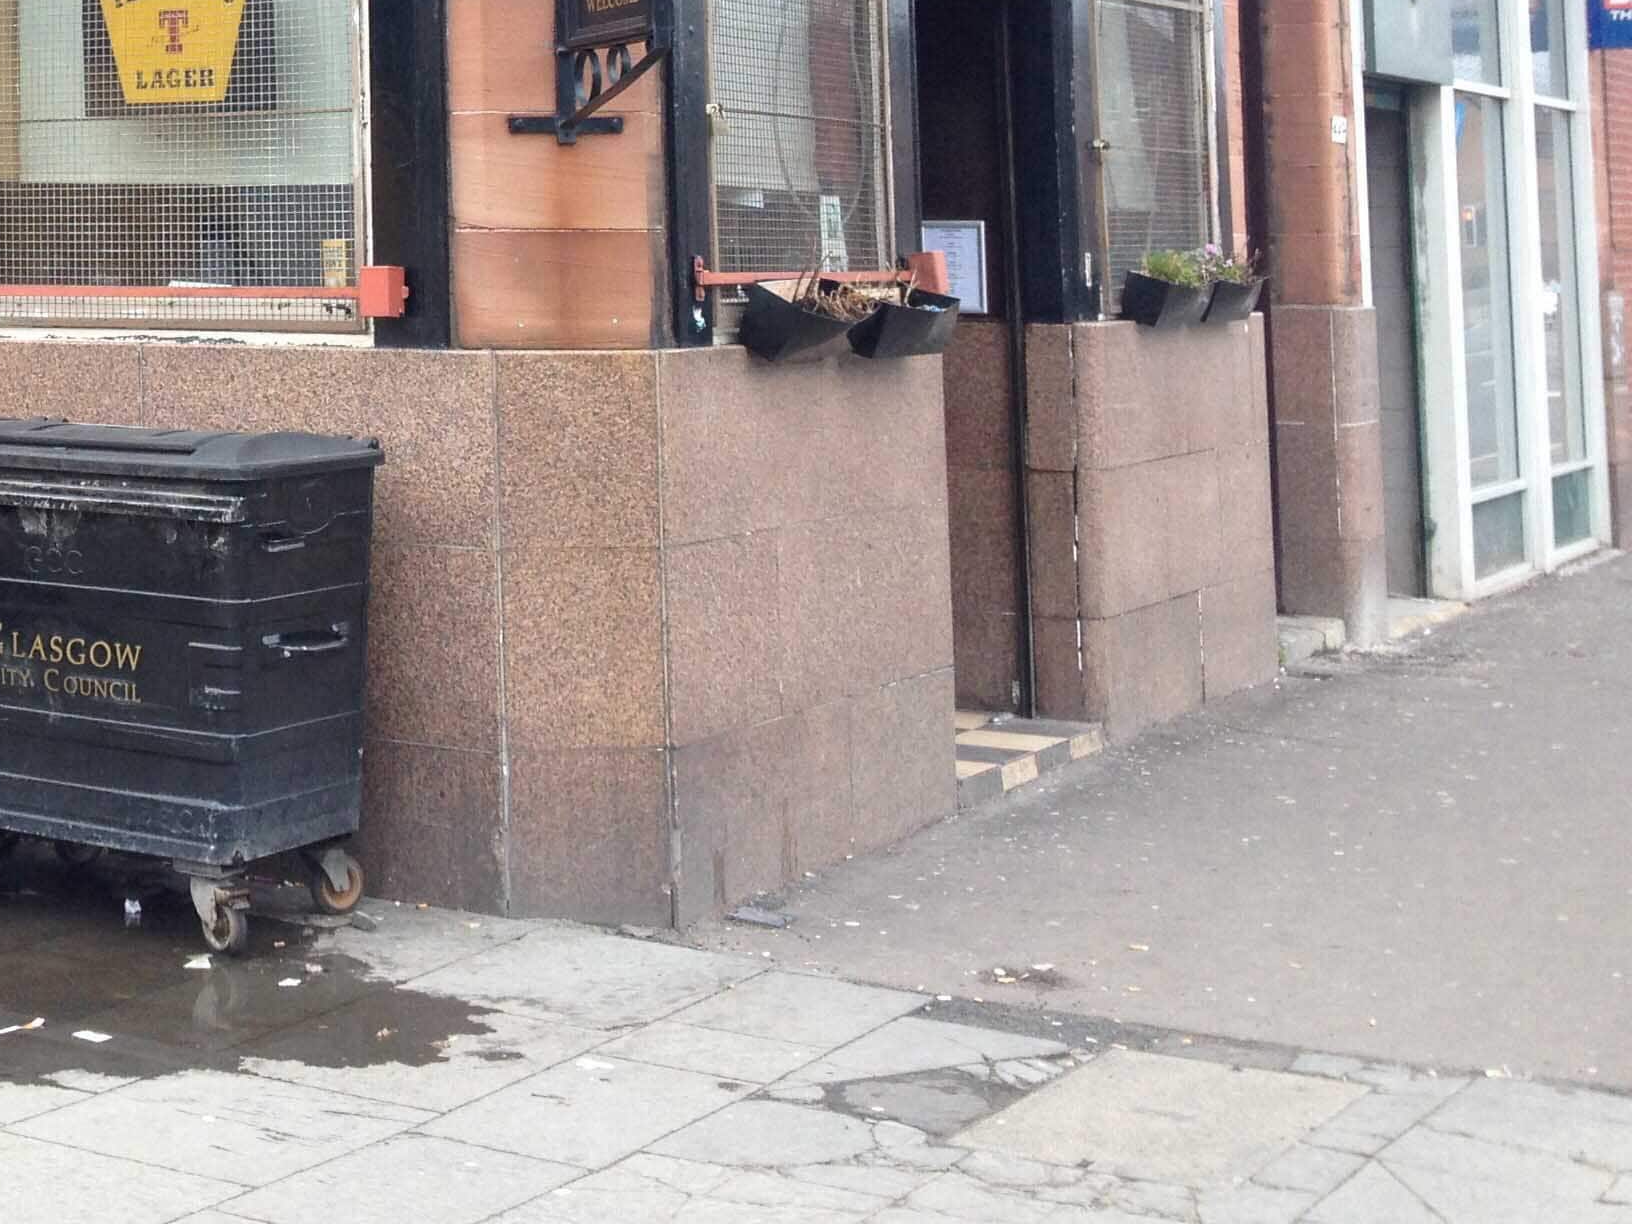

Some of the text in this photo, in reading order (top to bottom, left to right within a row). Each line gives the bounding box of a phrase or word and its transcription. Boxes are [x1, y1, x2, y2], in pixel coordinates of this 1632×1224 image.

[1609, 9, 1632, 21] TH
[158, 9, 189, 55] T
[136, 68, 215, 90] LAGER
[43, 668, 143, 704] COUNCIL
